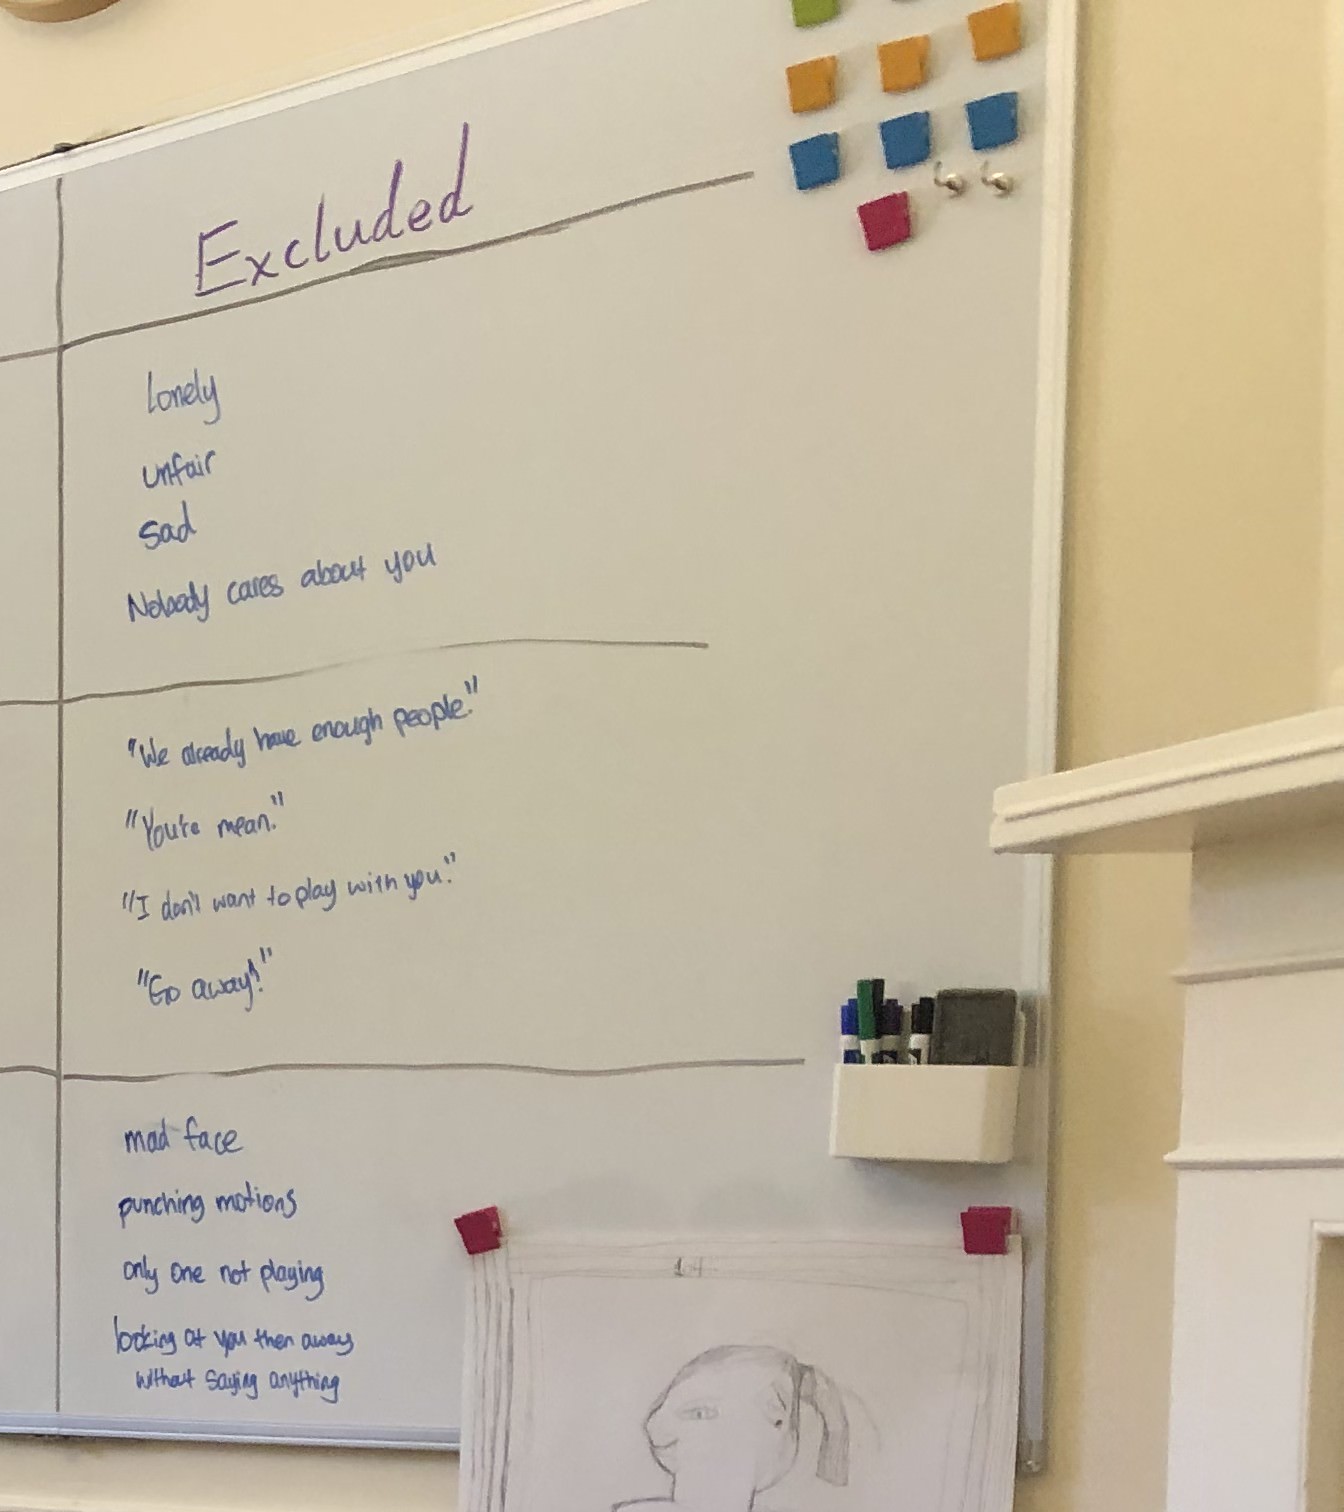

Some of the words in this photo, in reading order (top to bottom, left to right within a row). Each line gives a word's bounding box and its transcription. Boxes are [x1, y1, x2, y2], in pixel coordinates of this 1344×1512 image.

[195, 122, 473, 297] Excluded
[143, 450, 216, 489] unfair
[128, 582, 210, 623] Nobody
[227, 577, 284, 606] cares
[301, 556, 367, 589] about
[385, 543, 436, 583] you
[181, 727, 246, 768] already
[254, 726, 301, 751] have
[312, 708, 383, 746] enough
[162, 888, 200, 922] don't
[213, 887, 255, 910] want
[267, 884, 292, 908] to
[295, 877, 338, 912] play
[347, 872, 397, 897] with
[124, 1117, 169, 1154] mad
[184, 1115, 244, 1155] face
[118, 1189, 206, 1229] punching
[215, 1180, 297, 1219] motions
[123, 1254, 159, 1295] only
[170, 1261, 206, 1284] one
[220, 1259, 252, 1285] not
[260, 1258, 325, 1302] playing
[113, 1315, 177, 1356] looking
[213, 1329, 247, 1358] you
[254, 1327, 294, 1350] then
[301, 1332, 354, 1356] away
[136, 1366, 196, 1390] without
[205, 1369, 259, 1400] saying
[269, 1370, 341, 1404] anything
